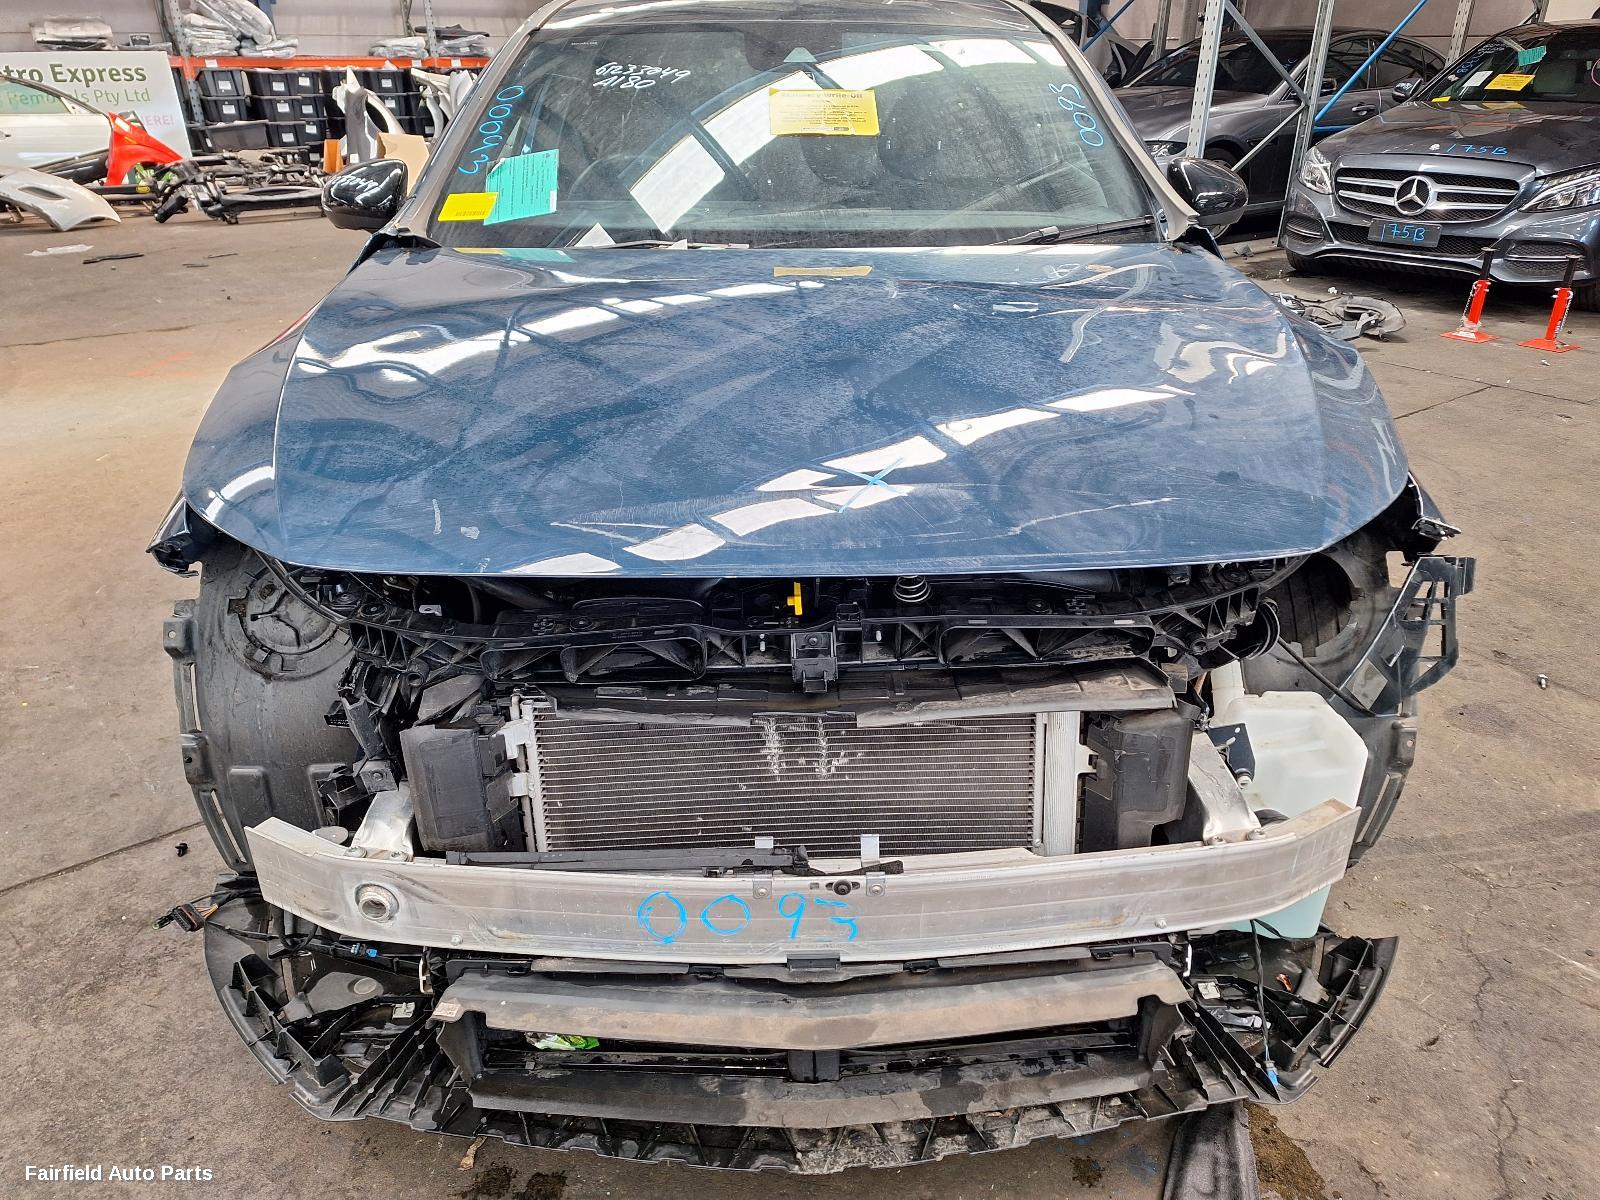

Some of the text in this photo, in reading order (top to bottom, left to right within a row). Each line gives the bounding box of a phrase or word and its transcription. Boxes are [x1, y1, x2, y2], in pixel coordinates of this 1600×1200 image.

[0, 64, 147, 87] tro Express
[592, 75, 656, 89] A180
[94, 89, 120, 105] Pty
[125, 88, 150, 102] Ltd
[143, 114, 174, 126] ERE!
[1446, 143, 1508, 155] 175B
[1380, 223, 1425, 242] 175B
